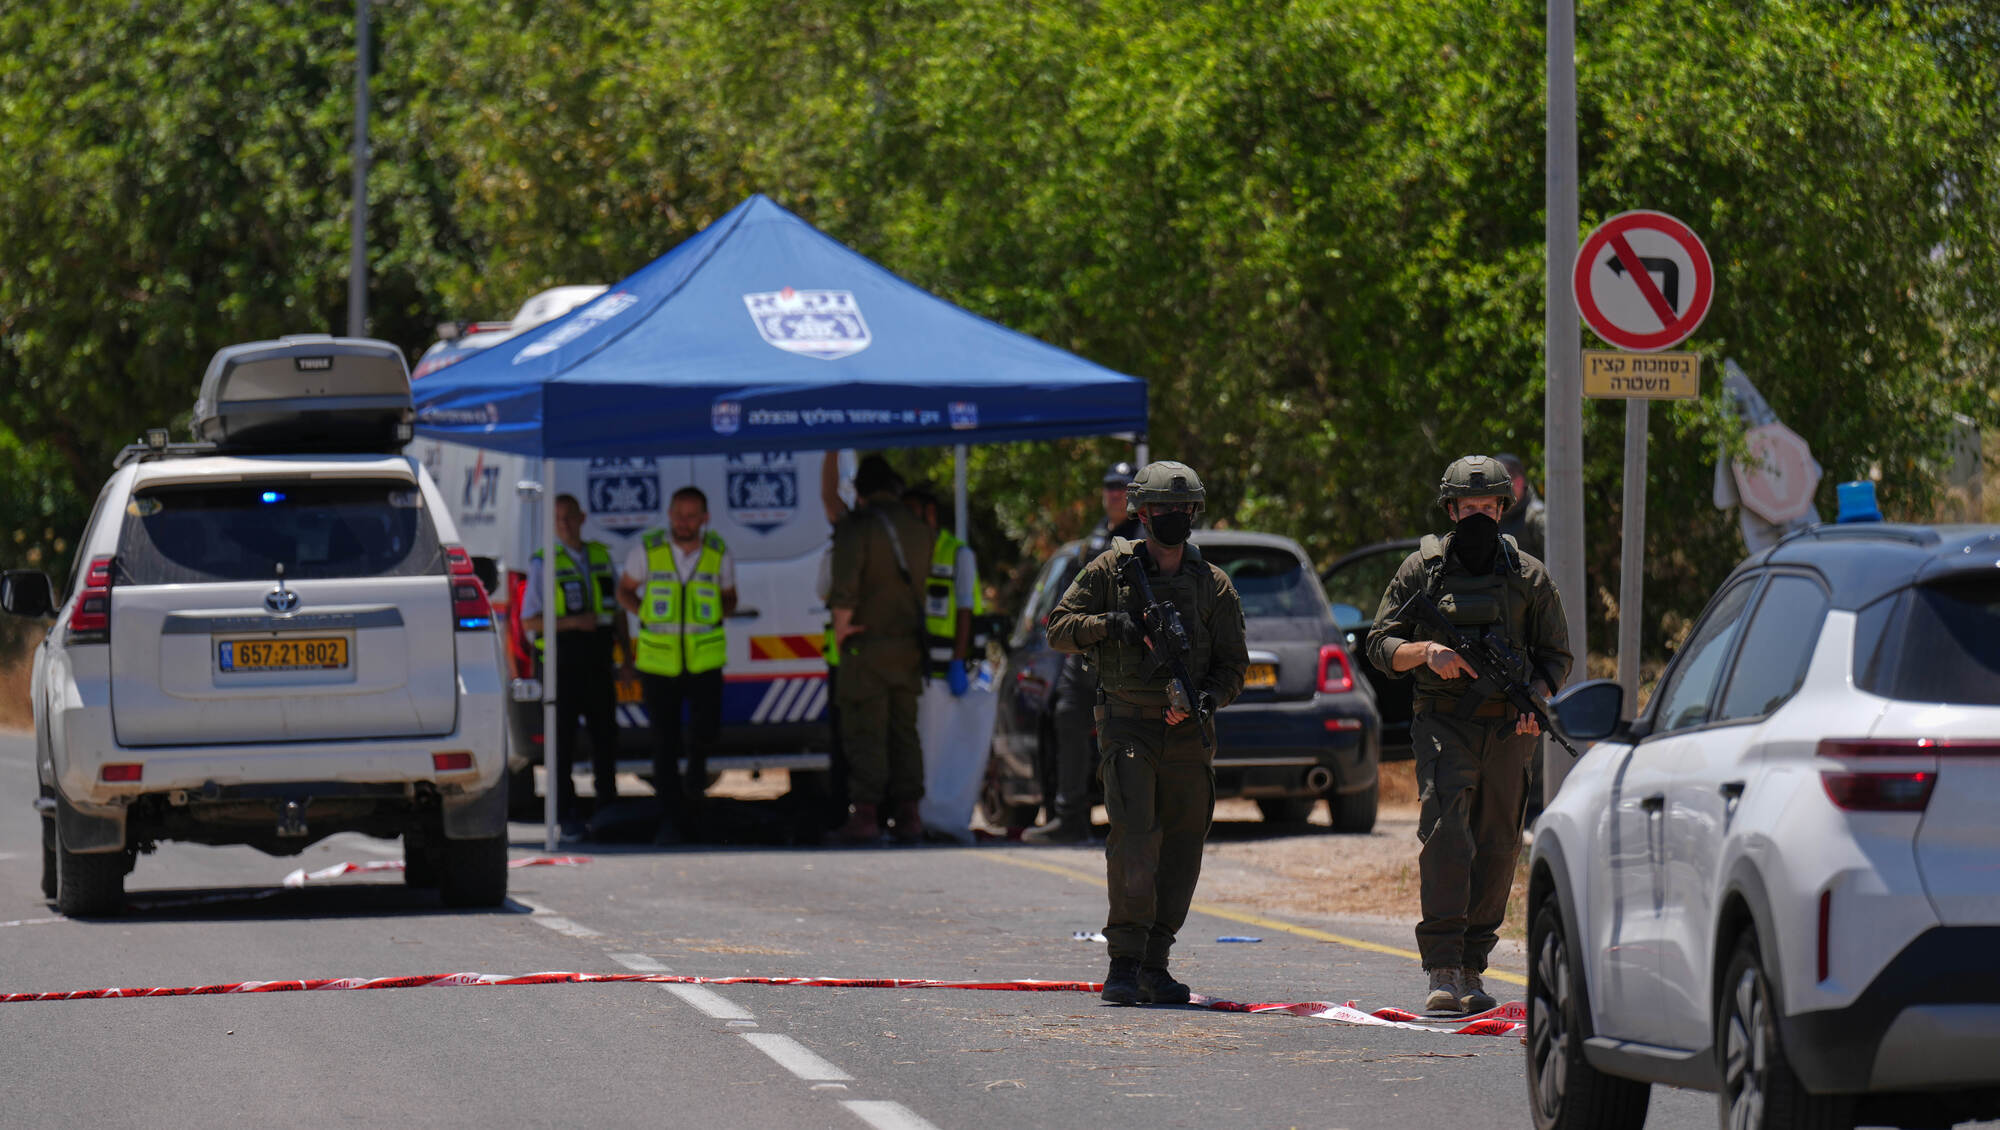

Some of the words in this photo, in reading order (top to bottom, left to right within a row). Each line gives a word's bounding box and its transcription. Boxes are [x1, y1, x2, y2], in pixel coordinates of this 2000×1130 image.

[1591, 358, 1625, 375] קצין
[1632, 358, 1690, 375] בסמכות
[1610, 376, 1670, 392] משטרה
